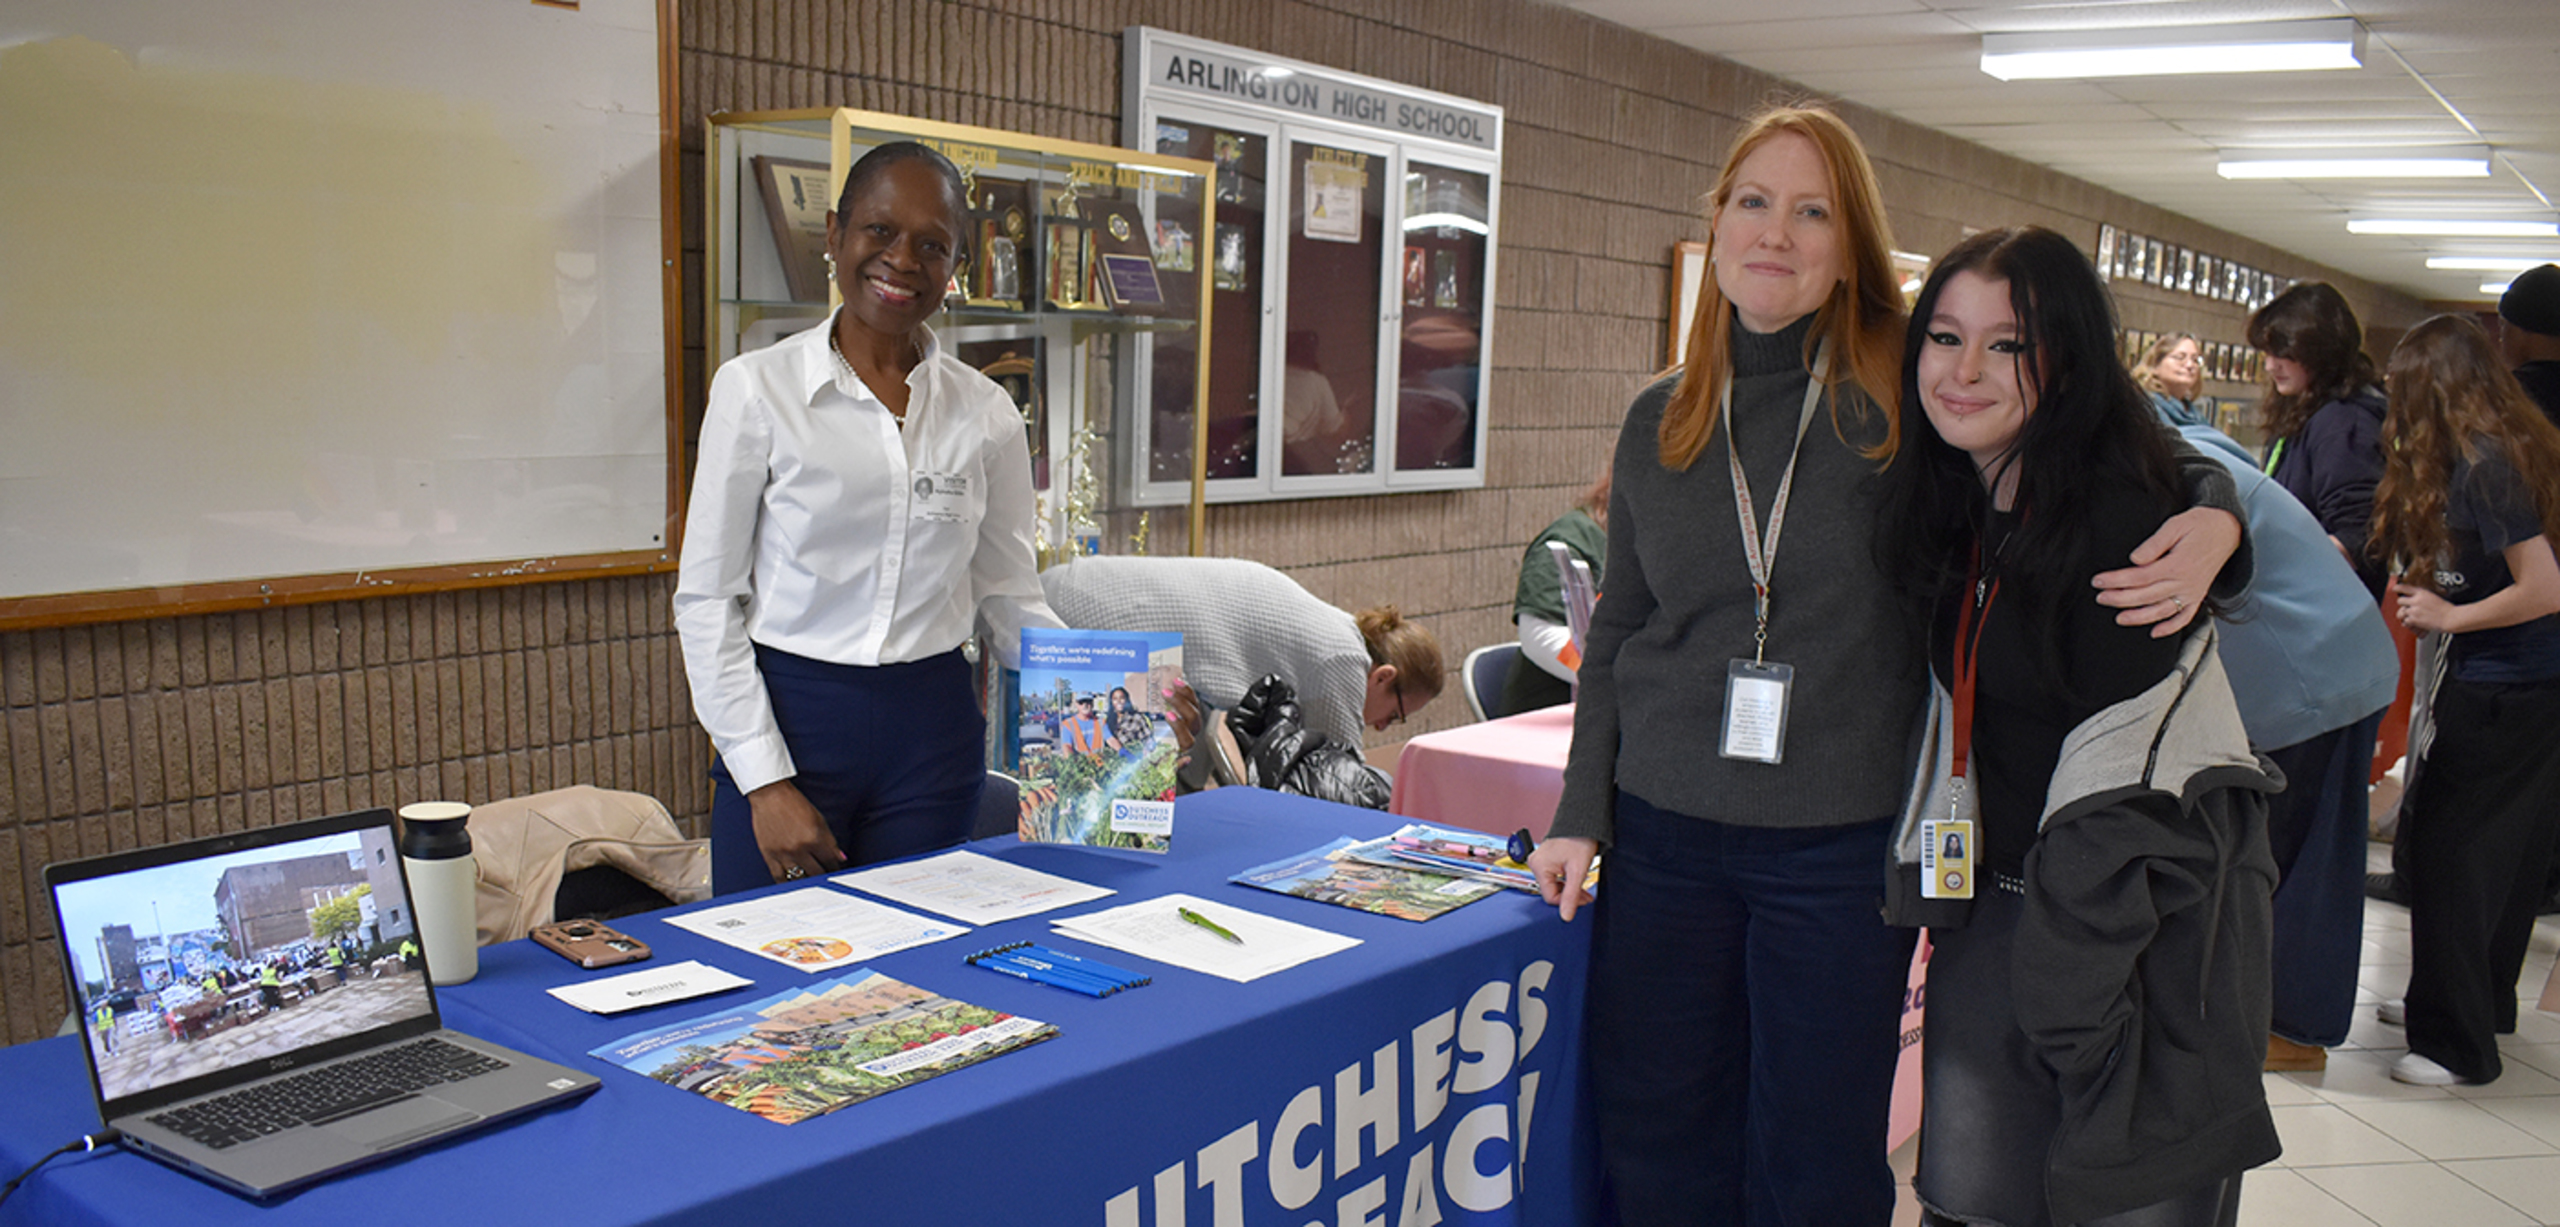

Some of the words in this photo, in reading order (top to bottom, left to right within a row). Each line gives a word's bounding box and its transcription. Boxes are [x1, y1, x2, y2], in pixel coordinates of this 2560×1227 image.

[1166, 55, 1319, 110] ARLINGTON
[1332, 90, 1387, 123] HIGH
[1398, 103, 1484, 142] SCHOOL
[1070, 161, 1114, 187] TRACK
[1029, 655, 1056, 663] what's
[1057, 655, 1092, 664] possible
[1068, 646, 1091, 655] we're
[1092, 646, 1136, 658] redefining
